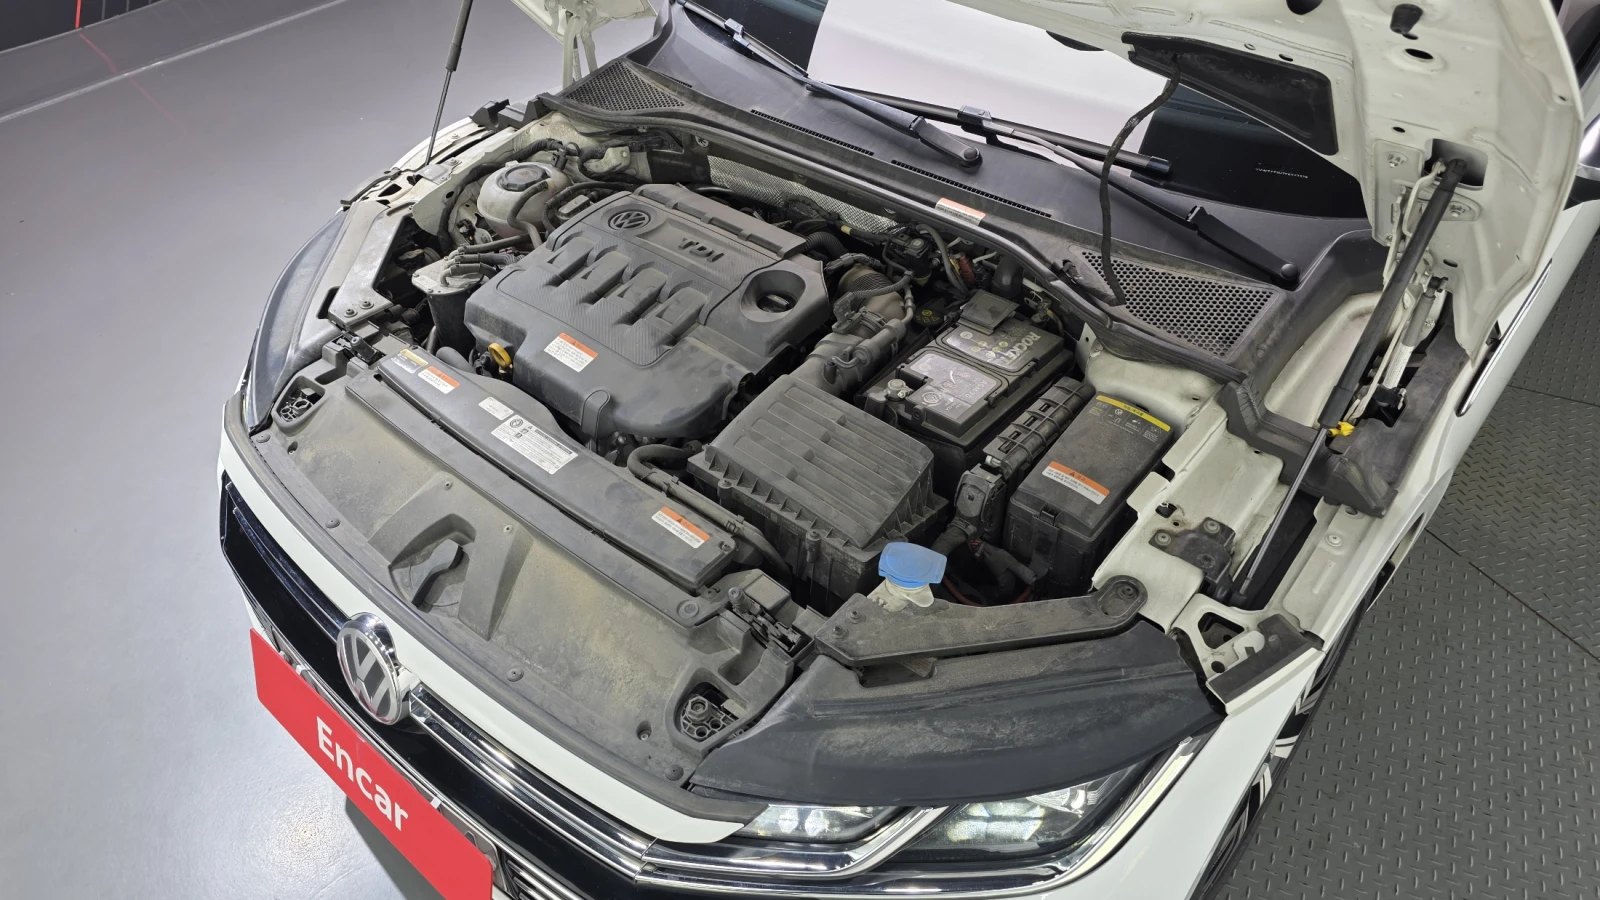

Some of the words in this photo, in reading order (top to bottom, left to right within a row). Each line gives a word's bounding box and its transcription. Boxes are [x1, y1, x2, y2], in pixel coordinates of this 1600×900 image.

[678, 237, 725, 262] TDI
[1003, 331, 1041, 363] ROCKET
[316, 716, 409, 831] Encar
